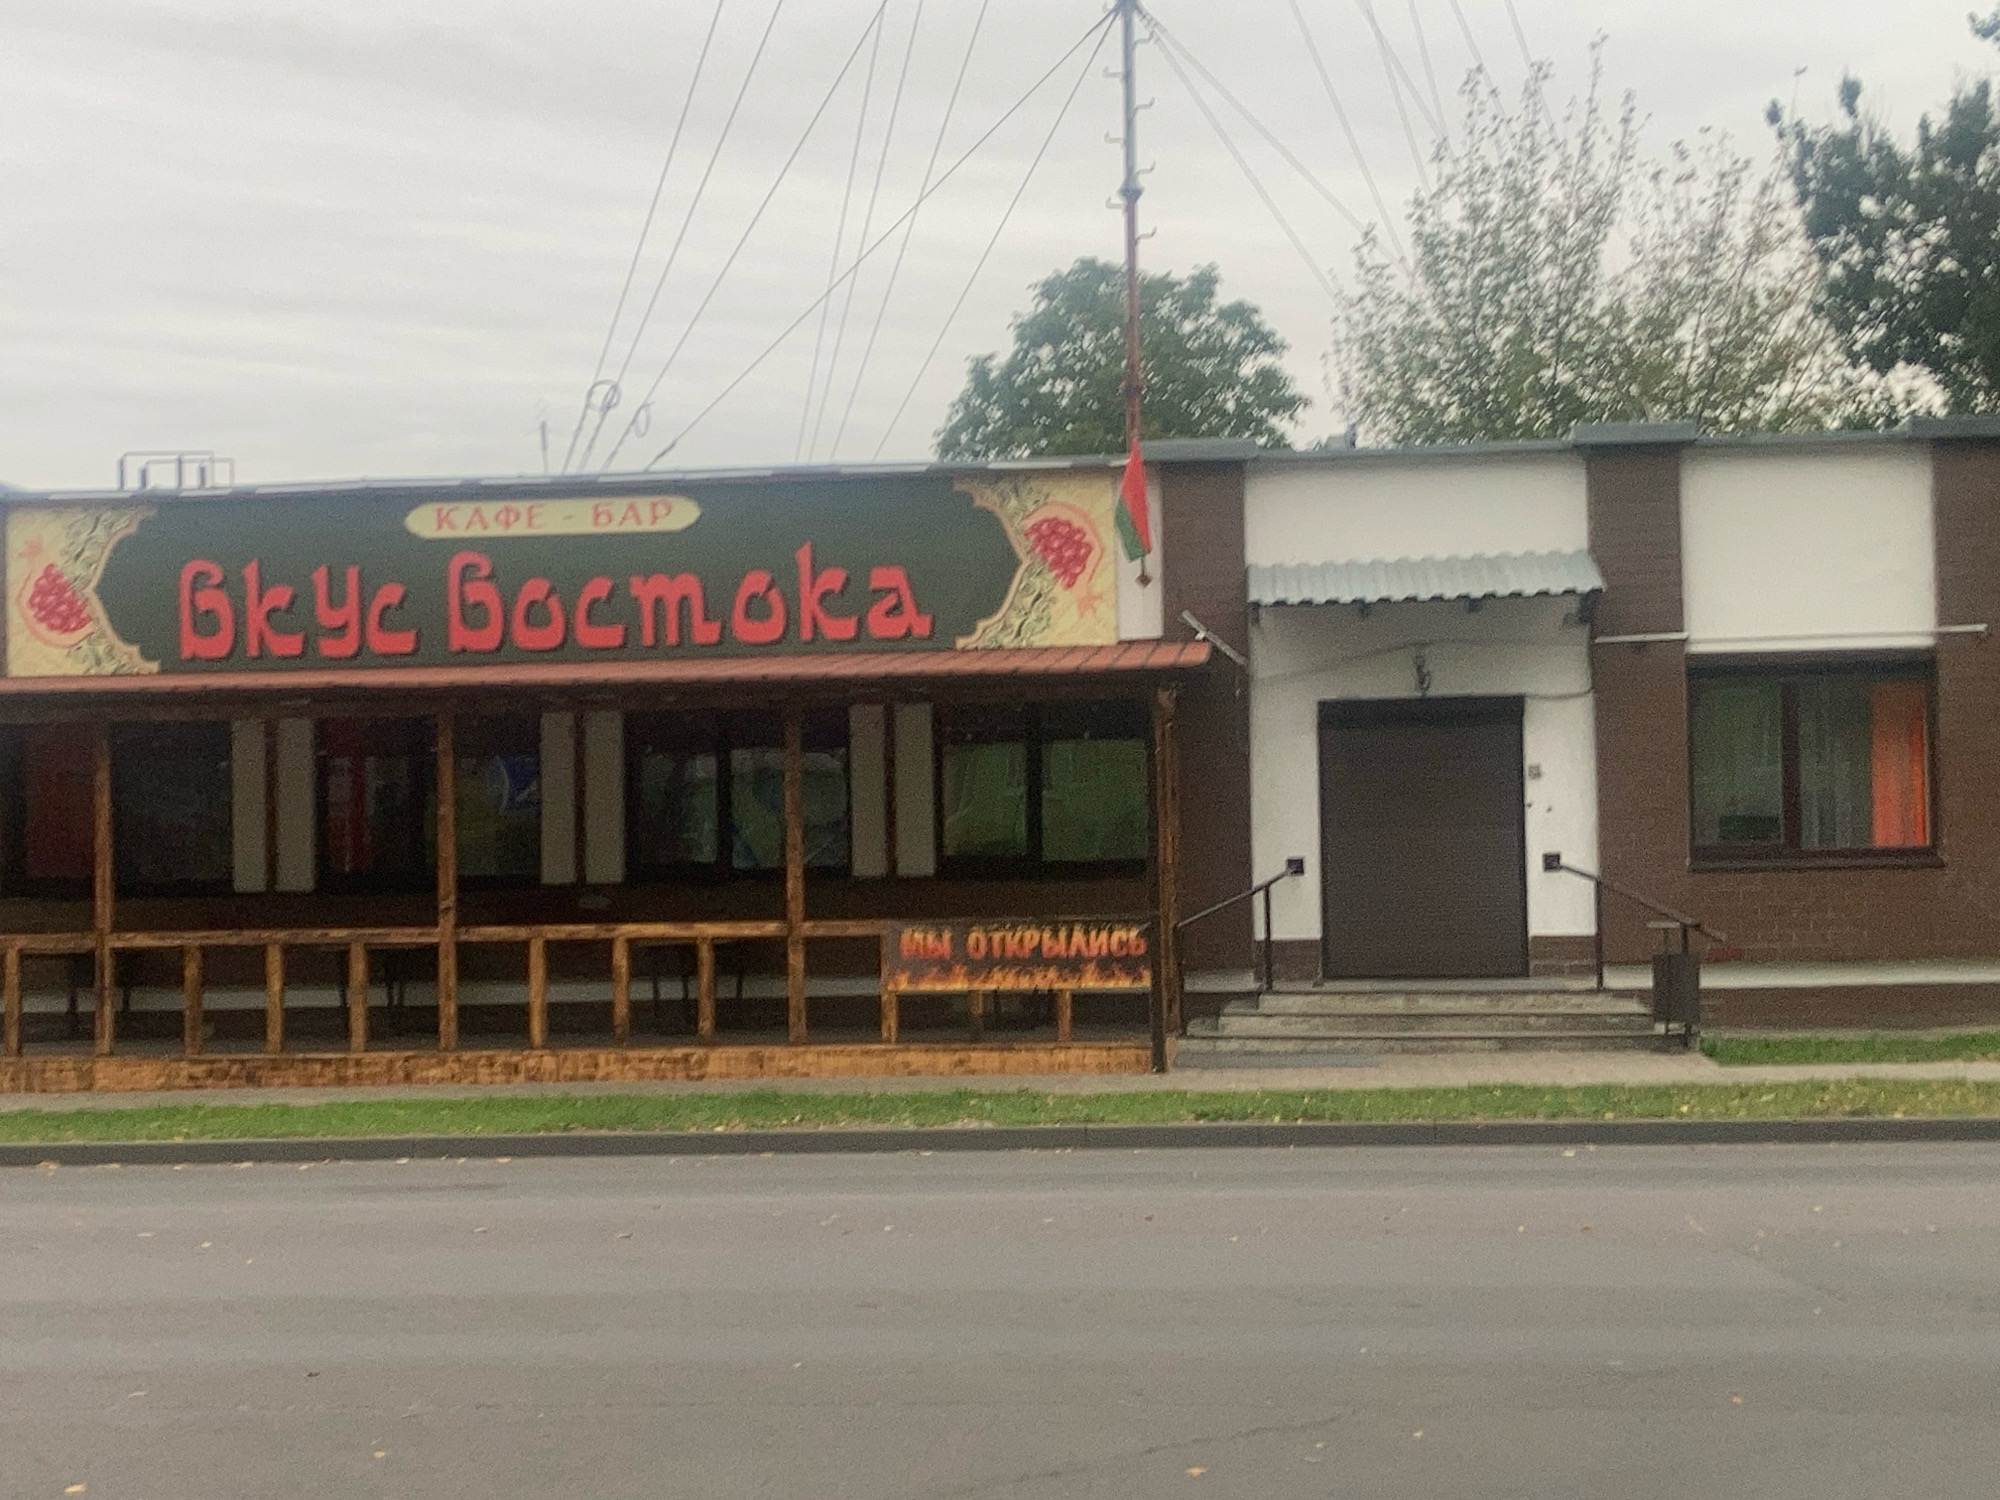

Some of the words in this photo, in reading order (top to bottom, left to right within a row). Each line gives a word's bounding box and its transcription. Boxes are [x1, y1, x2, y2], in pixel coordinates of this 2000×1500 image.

[434, 503, 547, 531] КАФЕ
[591, 499, 674, 528] БАР
[900, 926, 950, 958] МЫ
[966, 922, 1147, 959] ОТКРЫЛИСЬ
